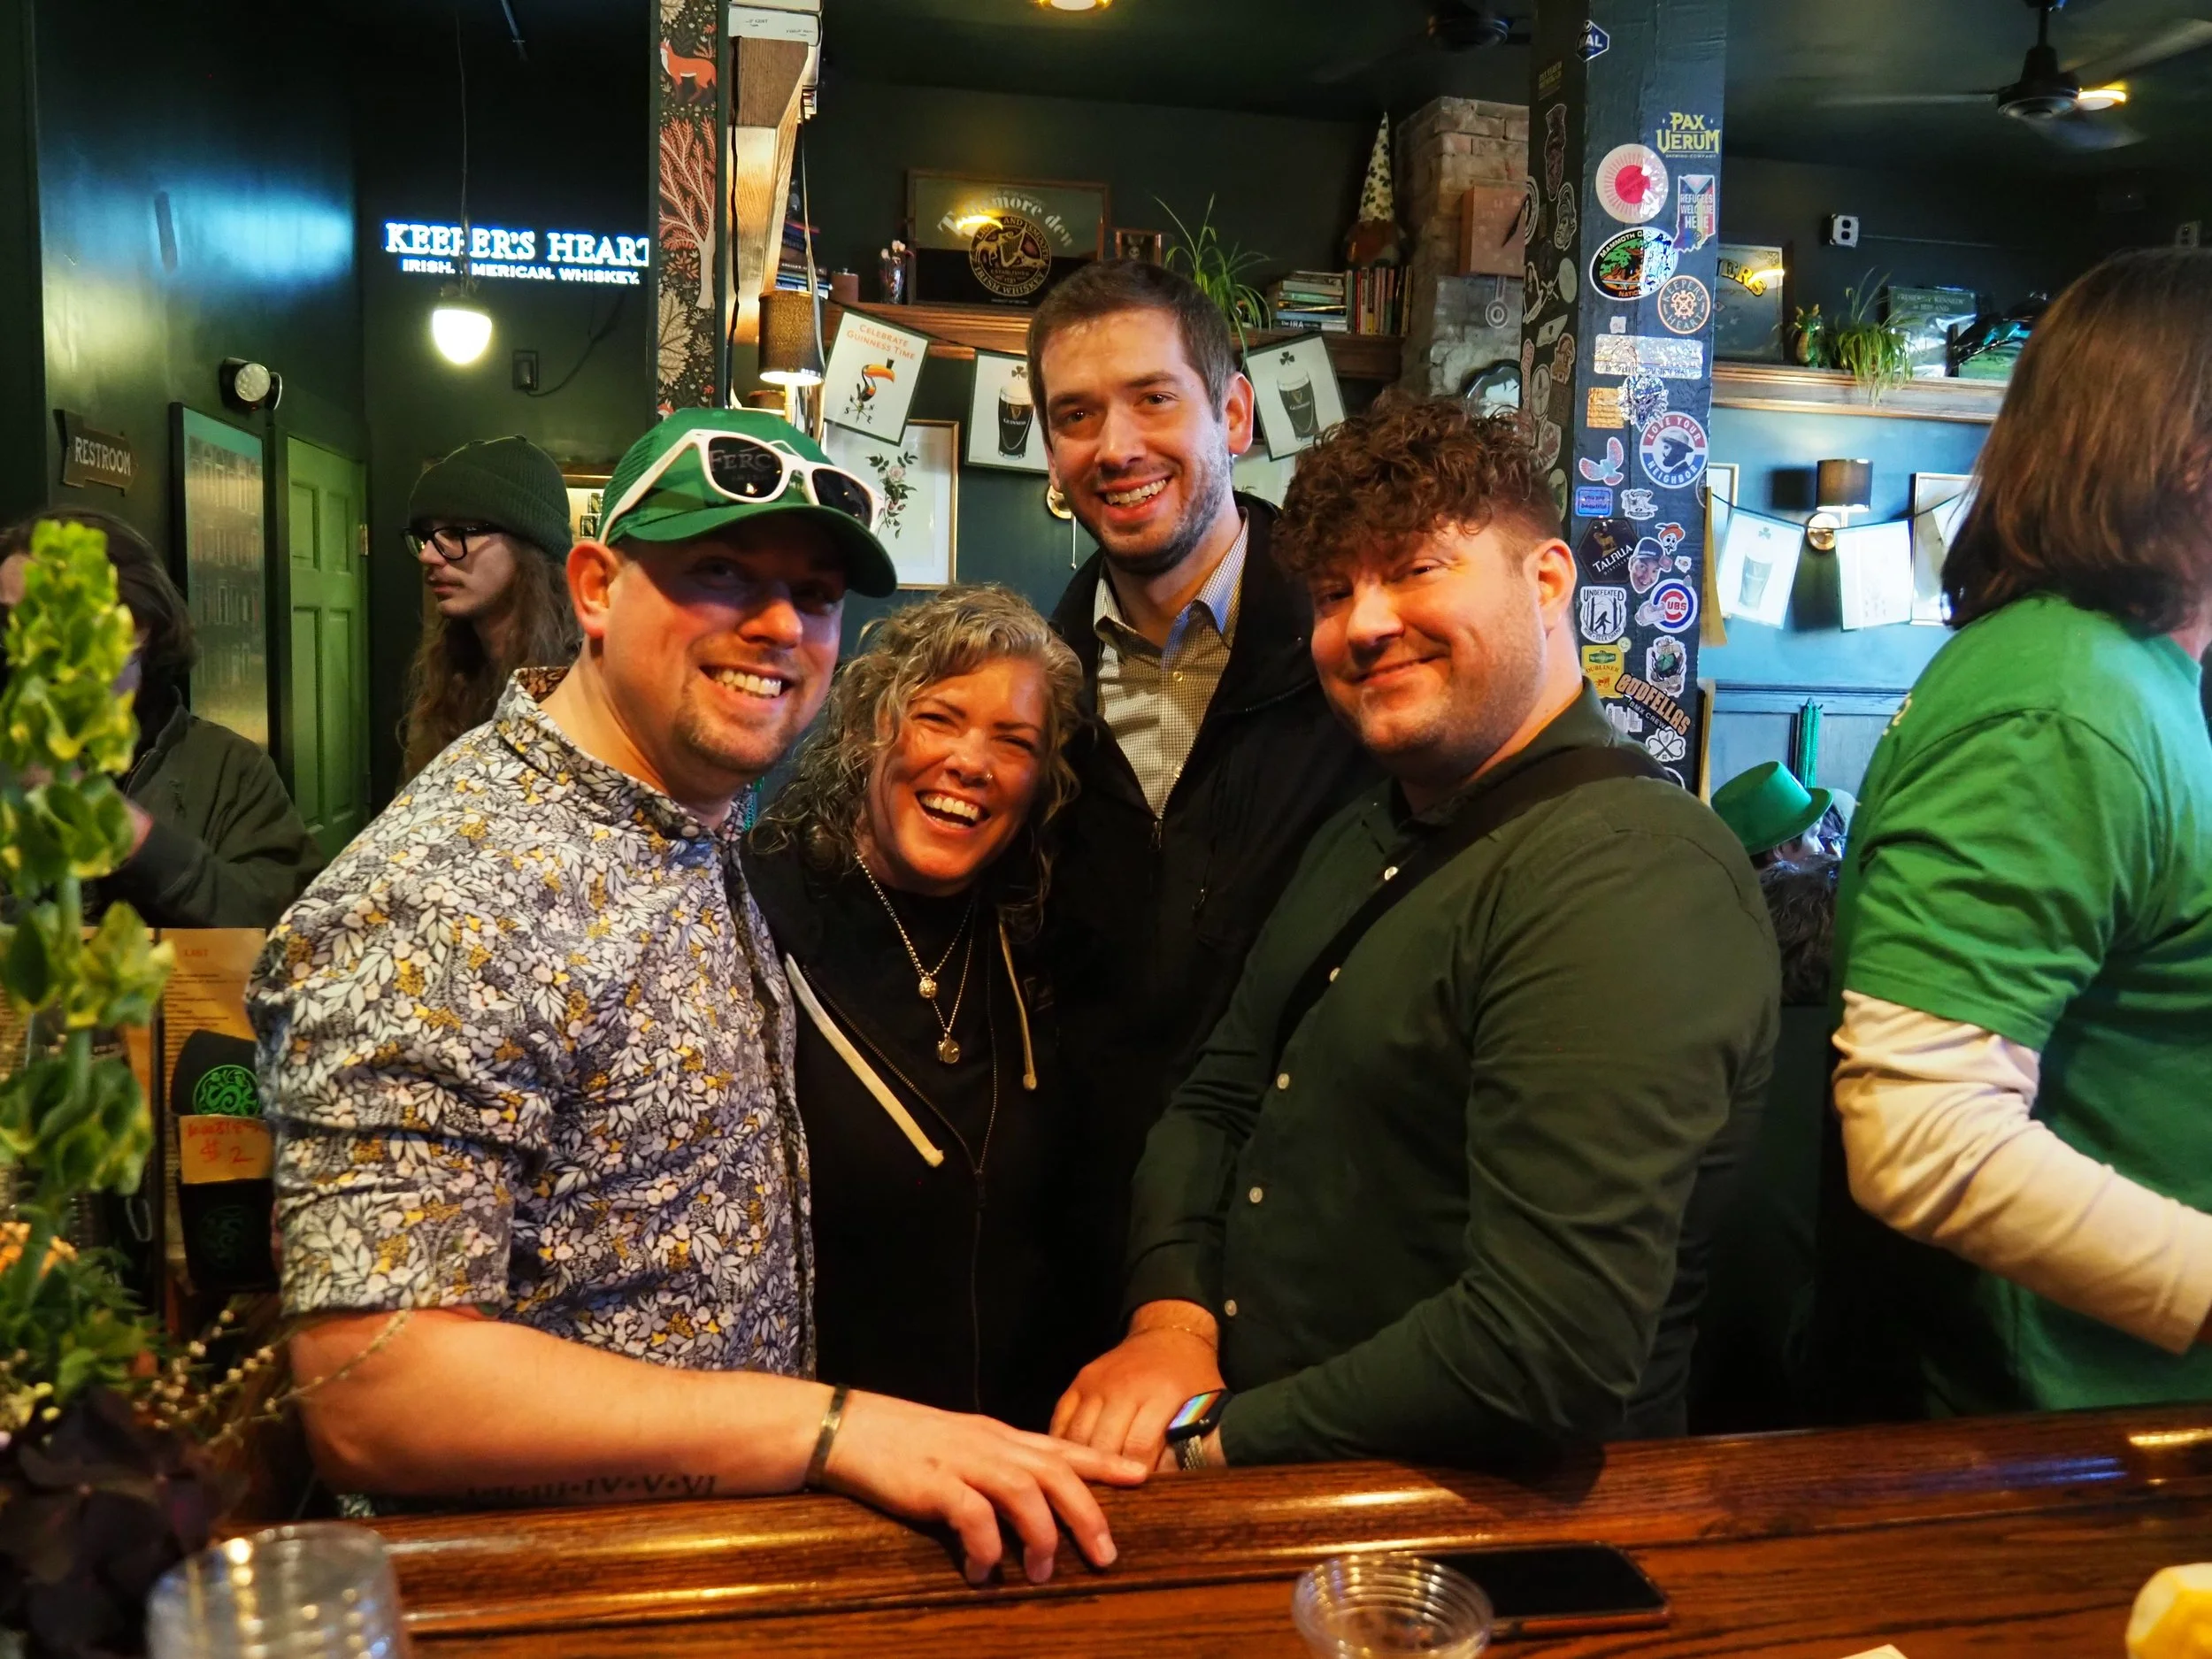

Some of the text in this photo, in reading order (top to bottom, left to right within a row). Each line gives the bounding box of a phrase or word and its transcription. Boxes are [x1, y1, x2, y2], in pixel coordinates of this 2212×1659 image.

[1669, 111, 1705, 132] PAX
[1655, 129, 1720, 154] VERUM
[1680, 194, 1713, 204] REFUGEES
[937, 197, 1042, 236] Tmore
[1003, 217, 1023, 227] AND
[1599, 233, 1635, 258] MAMMOTH
[460, 263, 556, 280] MERICAN.
[974, 266, 1045, 295] IRISH WHISKEY
[1717, 259, 1767, 297] ERS
[1662, 279, 1705, 303] KEEPER'S
[1290, 320, 1304, 329] IRA
[1667, 312, 1702, 330] HEART
[847, 330, 916, 360] GUINNESS TIME
[859, 324, 909, 347] CELEBRATE
[1647, 416, 1701, 441] LOVE YOUR
[75, 436, 131, 476] RESTROOM
[709, 449, 772, 472] FERC
[1647, 460, 1698, 484] NEIGHBOR
[1603, 557, 1630, 575] DISTILLER
[1583, 588, 1624, 603] UNDEFEATED
[1586, 664, 1619, 673] DUBLINER
[1629, 700, 1666, 728] BMX CREW
